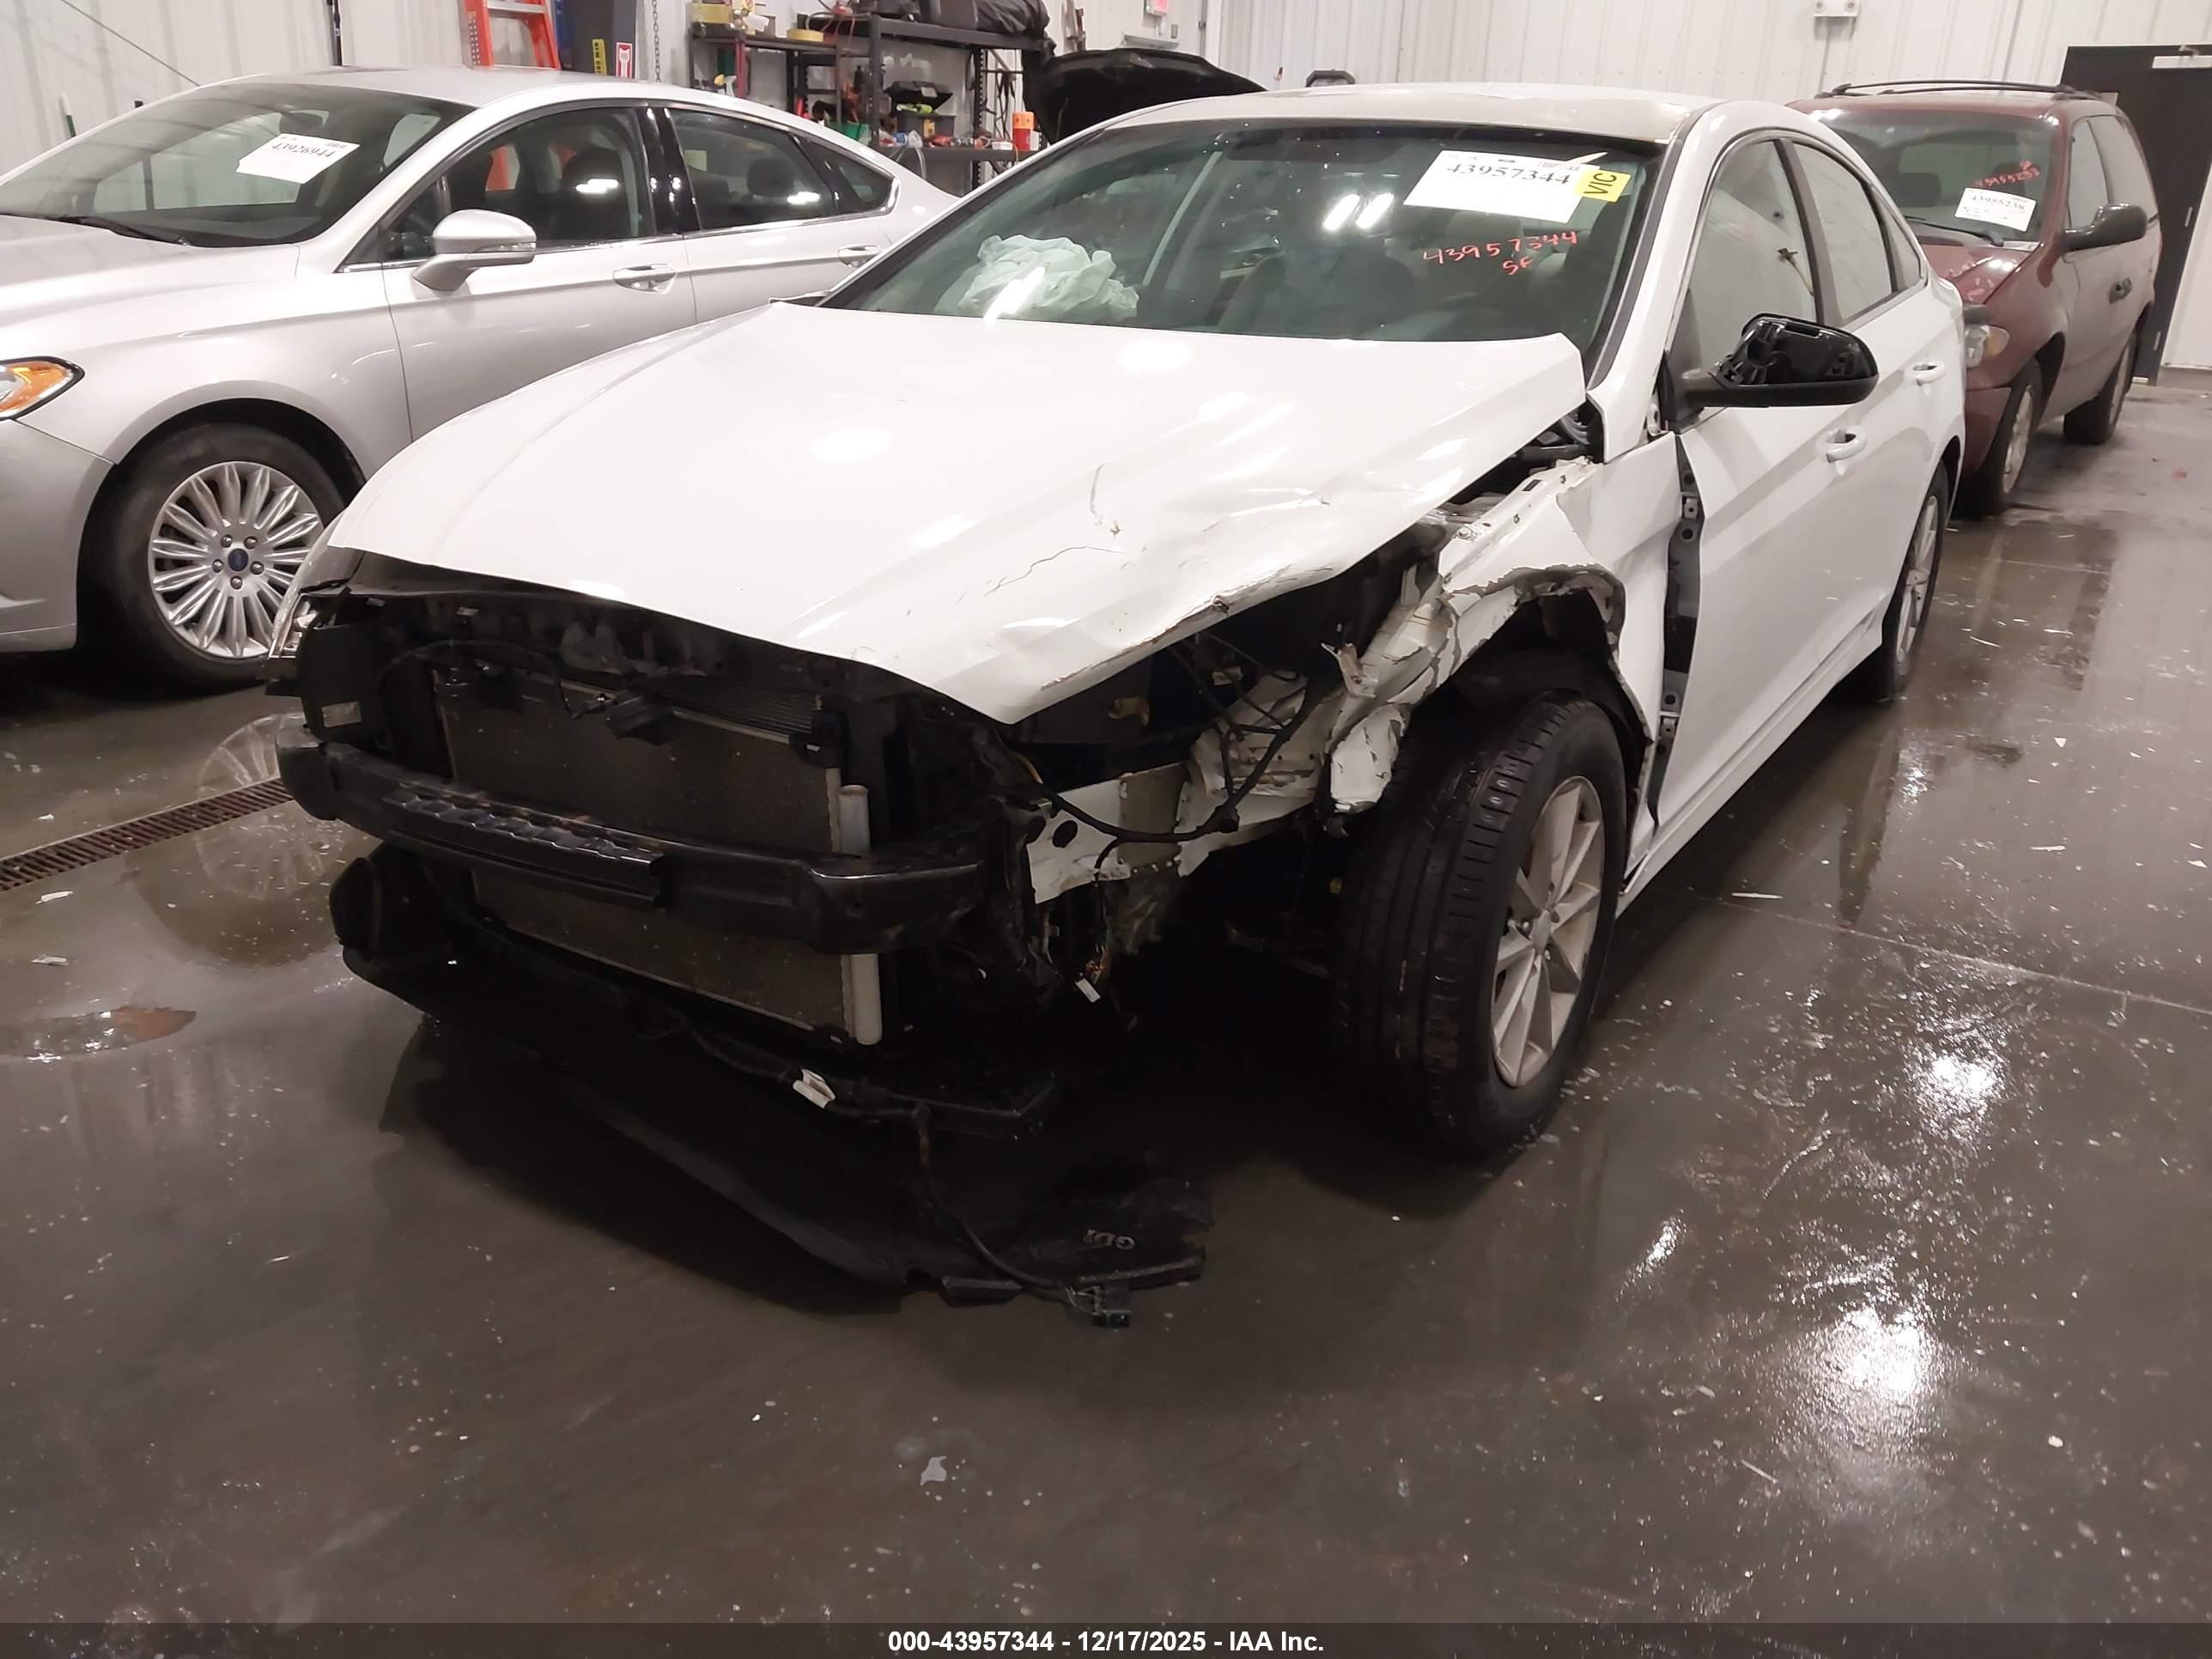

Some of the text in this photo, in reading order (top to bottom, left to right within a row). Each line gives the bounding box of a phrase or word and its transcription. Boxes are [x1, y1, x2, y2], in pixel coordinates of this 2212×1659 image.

[1446, 163, 1571, 185] 43957344
[1583, 173, 1618, 196] VIC
[1422, 230, 1578, 264] 43957344
